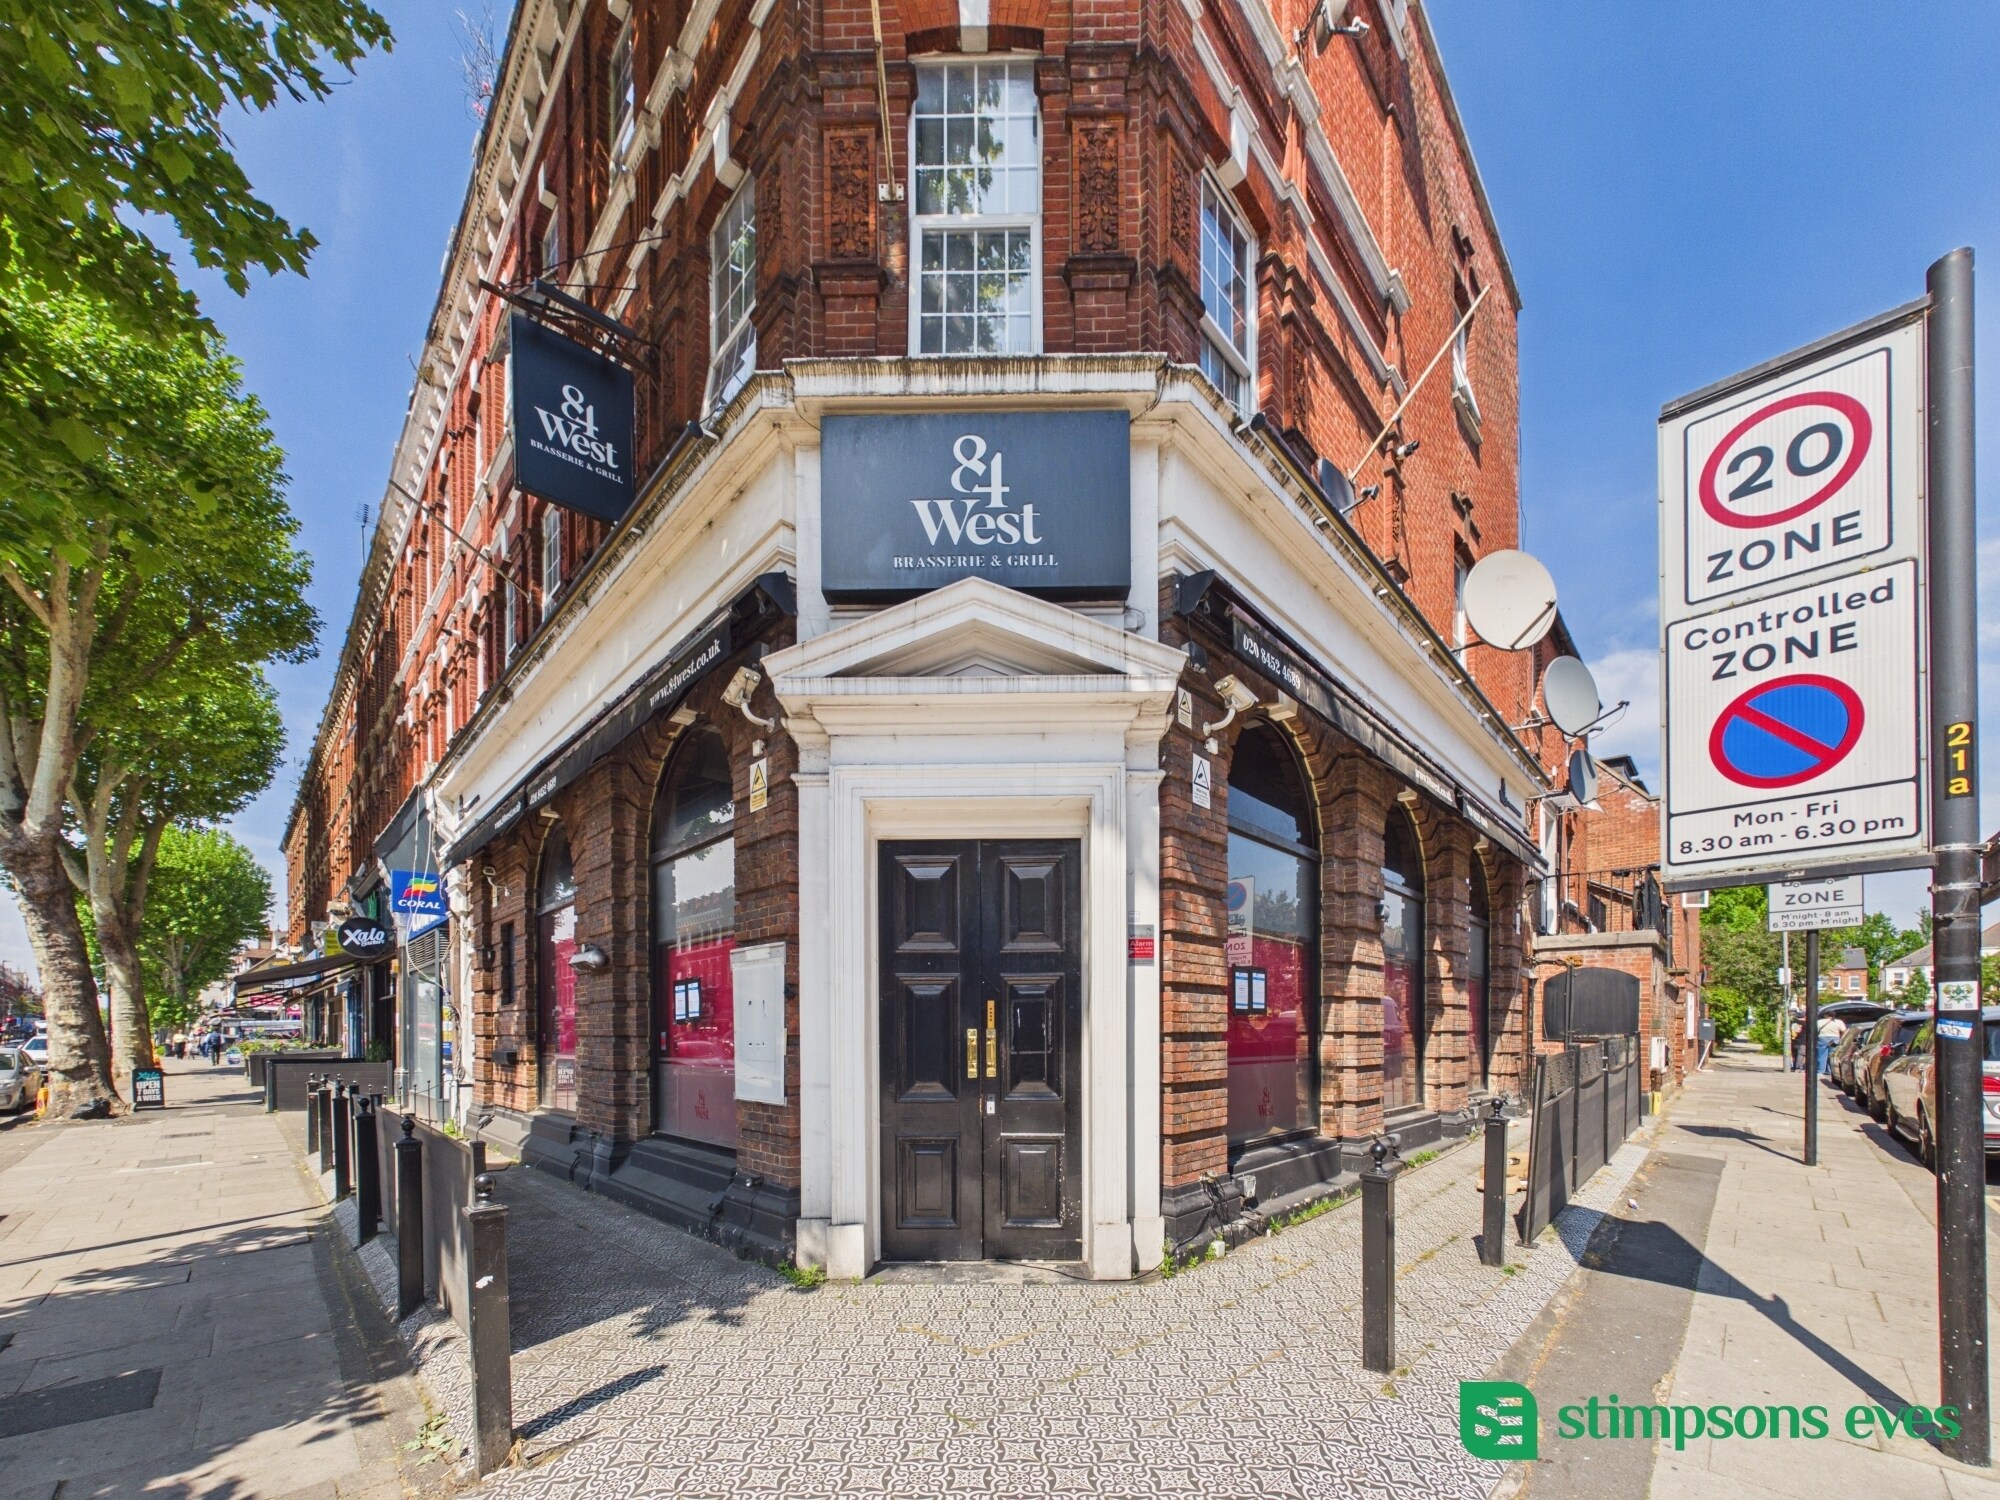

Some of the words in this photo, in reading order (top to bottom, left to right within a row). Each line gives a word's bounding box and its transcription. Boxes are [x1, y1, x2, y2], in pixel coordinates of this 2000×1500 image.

[561, 384, 598, 440] 84
[534, 406, 619, 469] West
[530, 439, 584, 468] BRASSERIE
[586, 461, 594, 472] &
[595, 466, 624, 484] GRILL
[951, 434, 1010, 508] 84
[1726, 422, 1844, 503] 20
[910, 499, 1042, 546] West
[893, 555, 985, 569] BRASSERIE
[990, 554, 1002, 567] &
[1007, 554, 1059, 567] GRILL
[1706, 510, 1863, 584] ZONE
[1685, 577, 1894, 651] Controlled
[649, 638, 721, 708] www.84west.co.uk
[1243, 634, 1259, 658] 020
[1261, 648, 1280, 675] 8452
[1282, 665, 1300, 690] 4689
[1711, 621, 1858, 681] ZONE
[1680, 835, 1733, 854] 8.30
[1739, 834, 1773, 847] am
[1795, 819, 1856, 840] 6.30
[1864, 816, 1905, 835] pm
[1733, 811, 1783, 828] Mon
[1806, 800, 1839, 818] Fri
[397, 899, 441, 910] CORAL
[1781, 912, 1818, 921] M'night
[1785, 889, 1845, 906] ZONE
[343, 927, 385, 946] Xalo
[1772, 921, 1796, 929] 6.30
[1798, 920, 1814, 928] pm
[1820, 916, 1859, 926] M'night
[136, 1081, 161, 1089] OPEN
